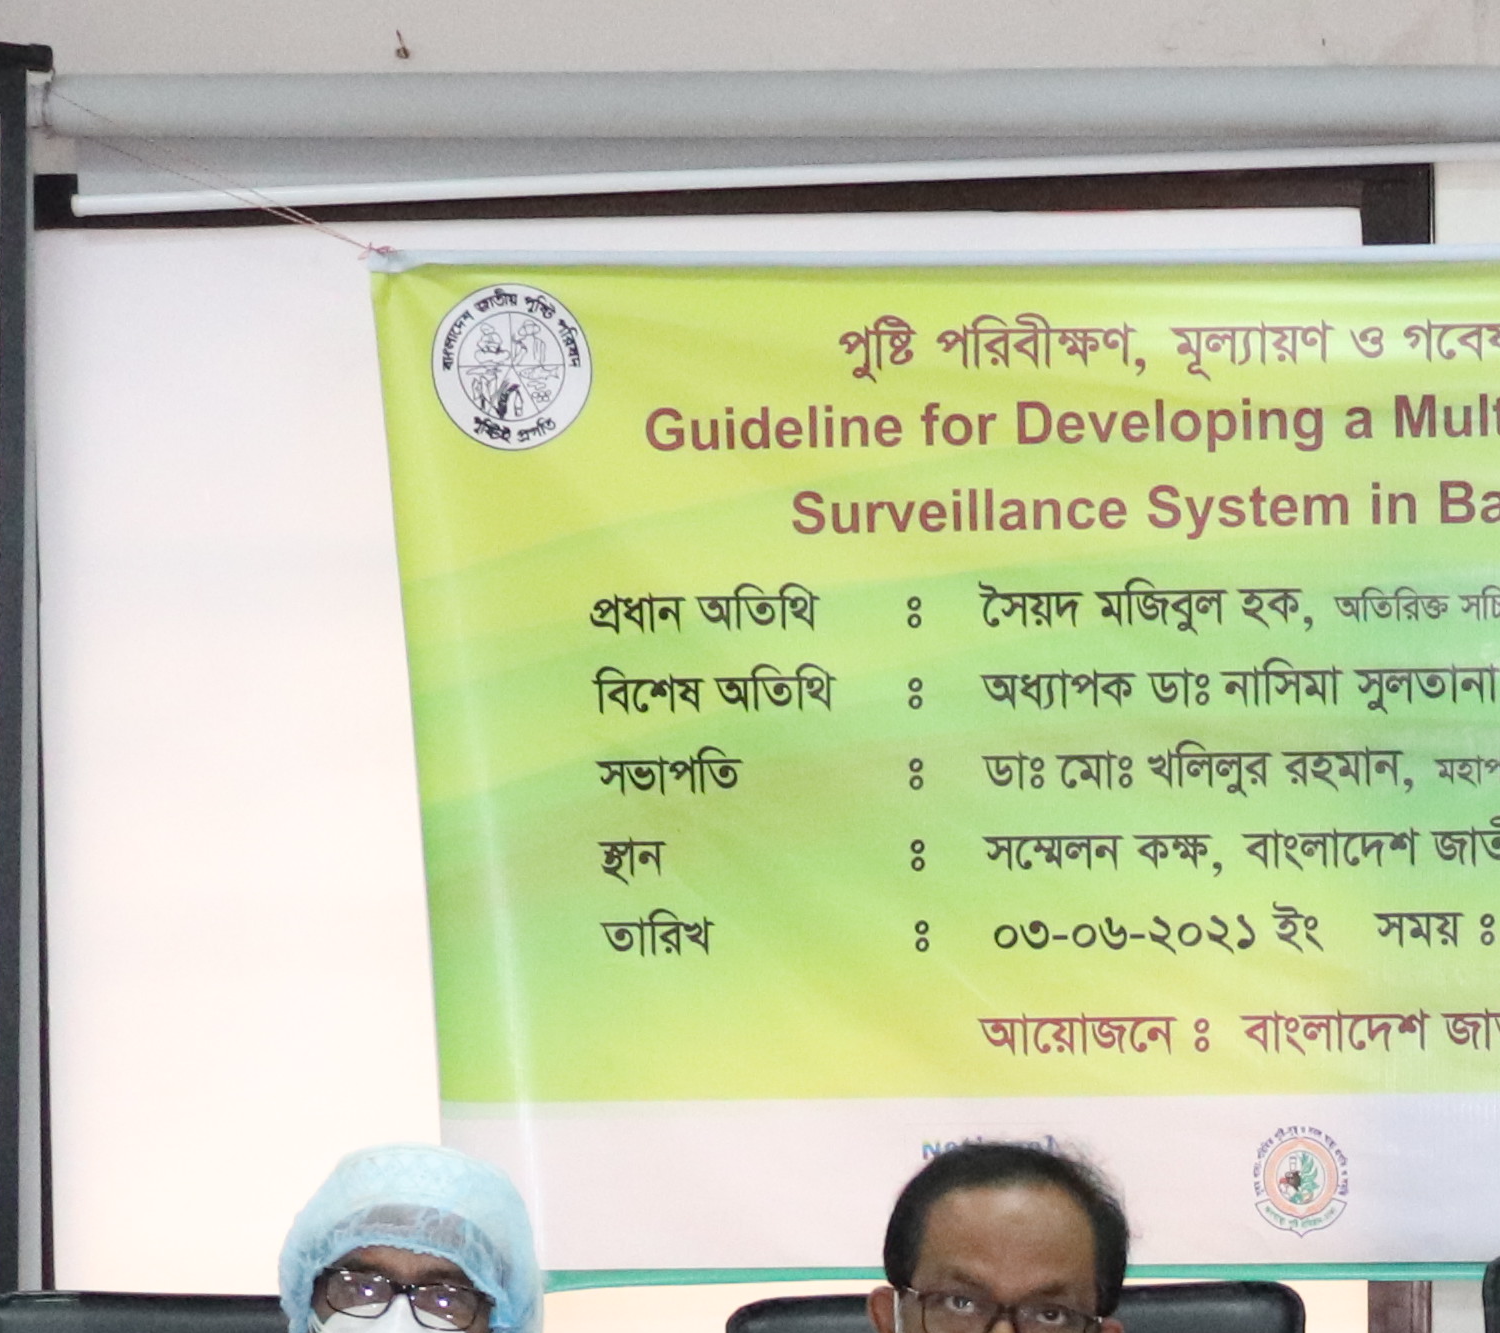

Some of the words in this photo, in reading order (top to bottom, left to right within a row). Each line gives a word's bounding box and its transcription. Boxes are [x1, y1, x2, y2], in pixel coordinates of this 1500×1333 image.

[839, 315, 917, 384] পুষ্টি
[936, 312, 1146, 376] পরিবীক্ষণ,
[1350, 326, 1384, 358] ও
[645, 405, 902, 452] Guideline
[920, 402, 997, 446] for
[1016, 397, 1323, 453] Developing
[1345, 406, 1373, 439] a
[792, 488, 1127, 535] Surveillance
[1148, 484, 1349, 540] System
[1371, 481, 1417, 525] in
[590, 594, 685, 634] প্রধান
[696, 582, 820, 630] অতিথি
[978, 581, 1083, 627] সৈয়দ
[1094, 577, 1228, 634] মজিবুল
[1237, 588, 1313, 631] হক,
[1333, 586, 1449, 622] অতিরিক্ত
[592, 666, 704, 714] বিশেষ
[714, 663, 836, 711] অতিথি
[980, 670, 1136, 709] অধ্যাপক
[1220, 657, 1343, 706] নাসিমা
[596, 745, 742, 795] সভাপতি
[1147, 739, 1272, 797] খলিলুর
[1281, 746, 1413, 793] রহমান,
[598, 838, 666, 885] স্থান
[983, 835, 1123, 870] সম্মেলন
[1133, 834, 1222, 877] কক্ষ,
[1242, 827, 1420, 870] বাংলাদেশ
[600, 908, 714, 956] তারিখ
[1272, 902, 1323, 952] ইং
[1374, 912, 1464, 947] সময়
[977, 1012, 1177, 1056] আয়োজনে
[1240, 1008, 1431, 1055] বাংলাদেশ
